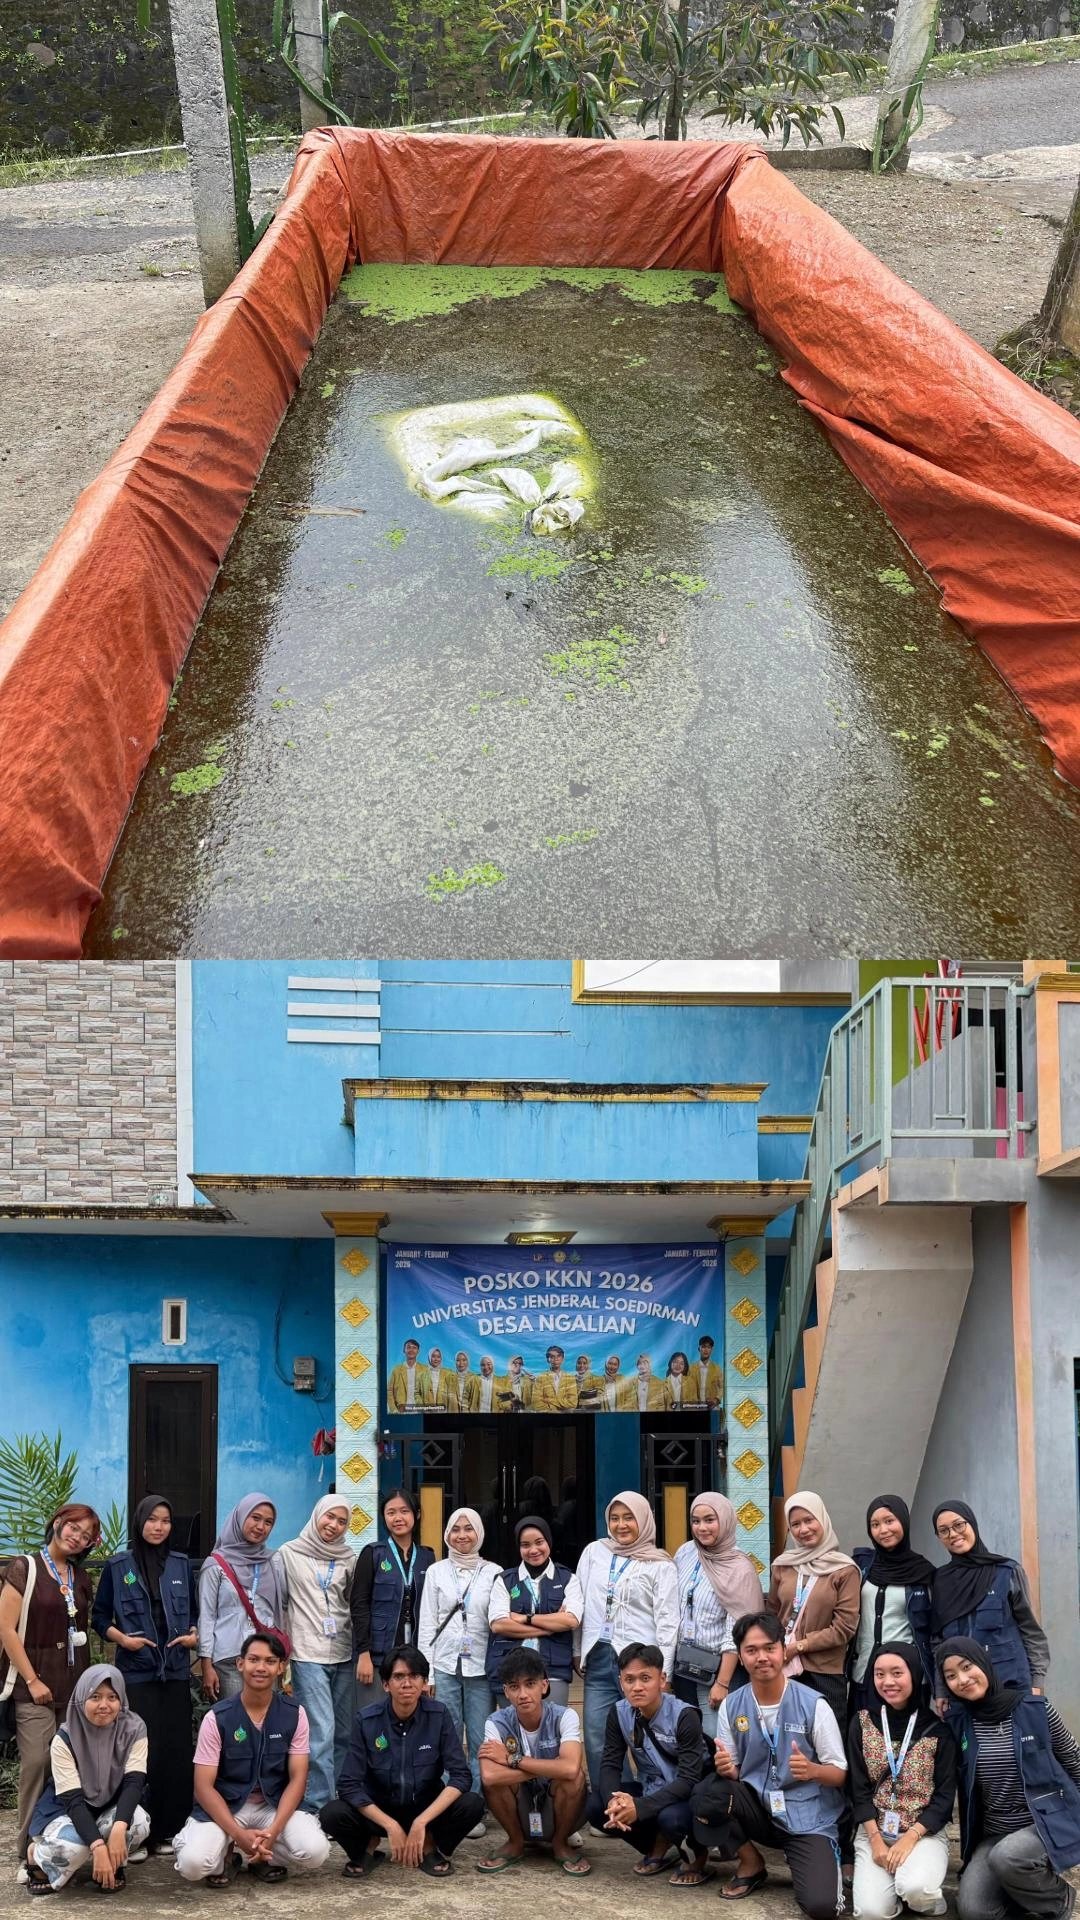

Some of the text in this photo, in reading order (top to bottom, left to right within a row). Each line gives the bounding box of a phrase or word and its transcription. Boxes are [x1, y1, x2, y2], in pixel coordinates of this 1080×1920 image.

[463, 1270, 654, 1294] POSKO KKN 2026
[412, 1294, 701, 1329] UNIVERSITAS JENDERAL SOEDIRMAN
[478, 1314, 636, 1336] DESA NGALIAN
